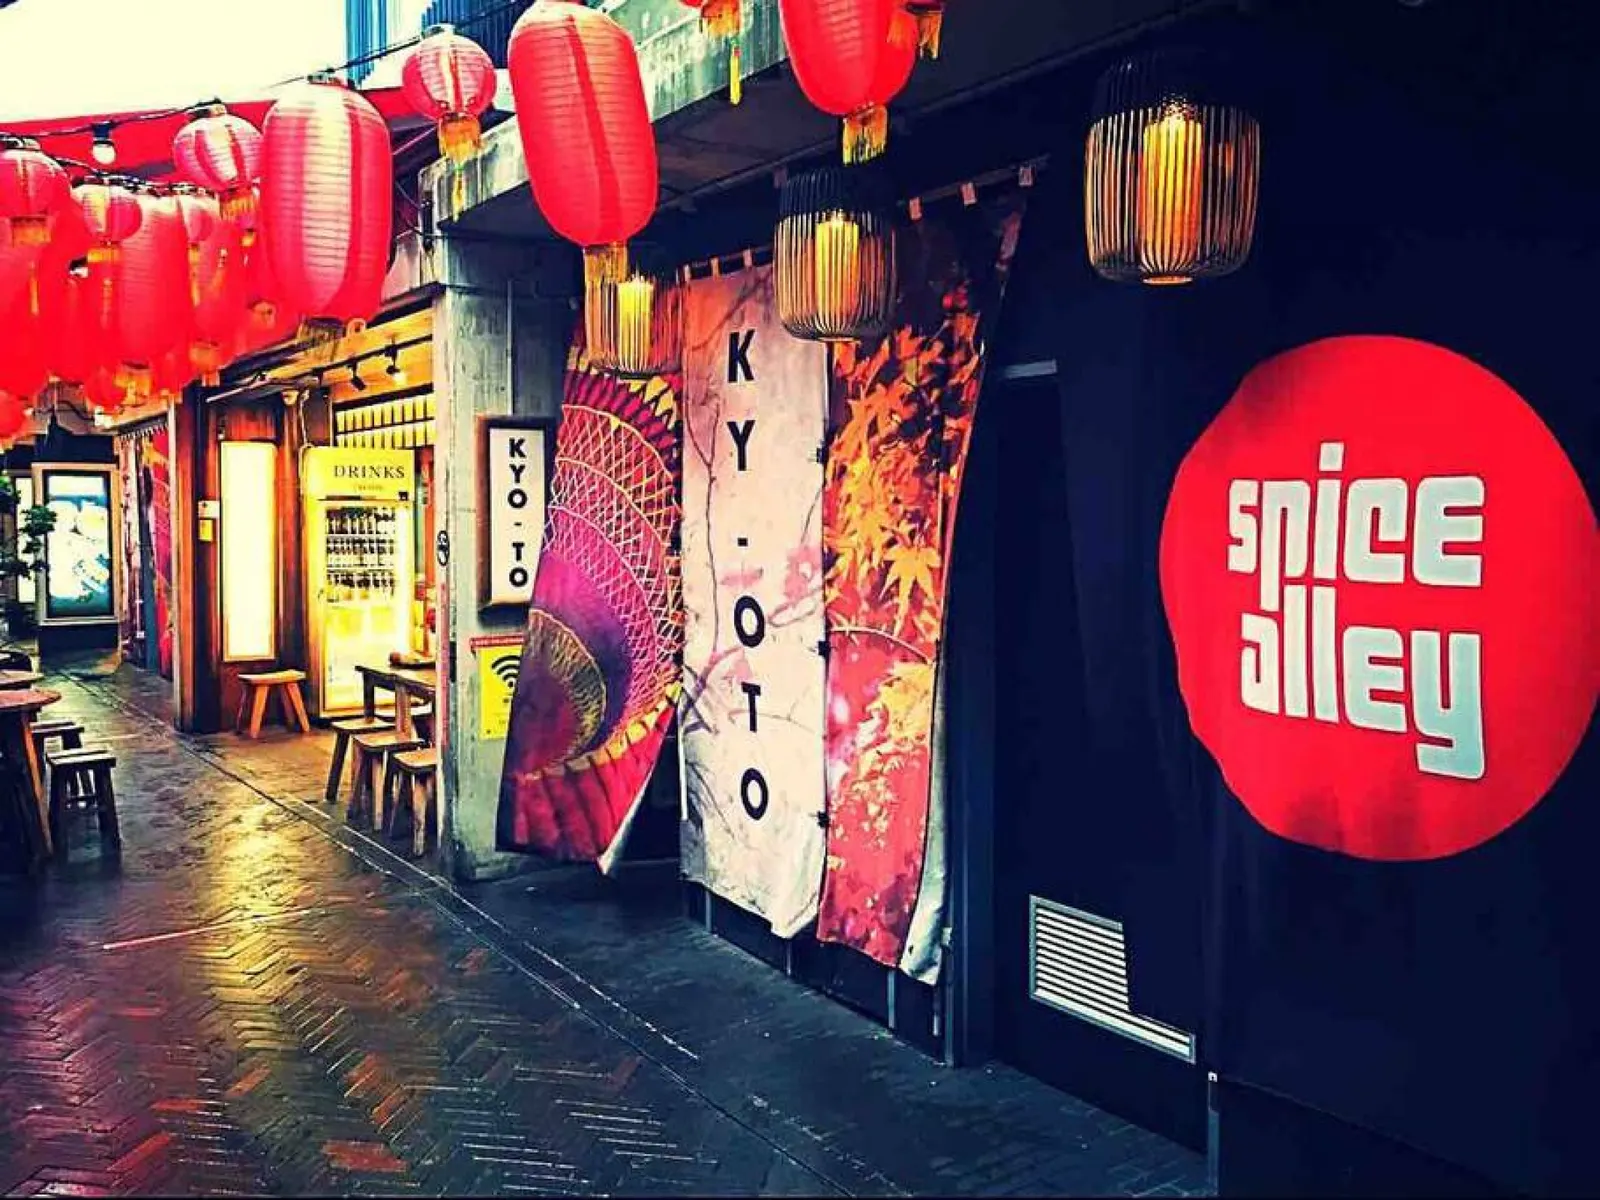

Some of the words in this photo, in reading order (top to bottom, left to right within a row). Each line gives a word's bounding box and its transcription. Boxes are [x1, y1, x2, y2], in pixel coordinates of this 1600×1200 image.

[333, 464, 406, 479] DRINKS
[508, 438, 529, 588] KYO-TO
[1227, 441, 1485, 612] spice
[1240, 584, 1485, 780] alley
